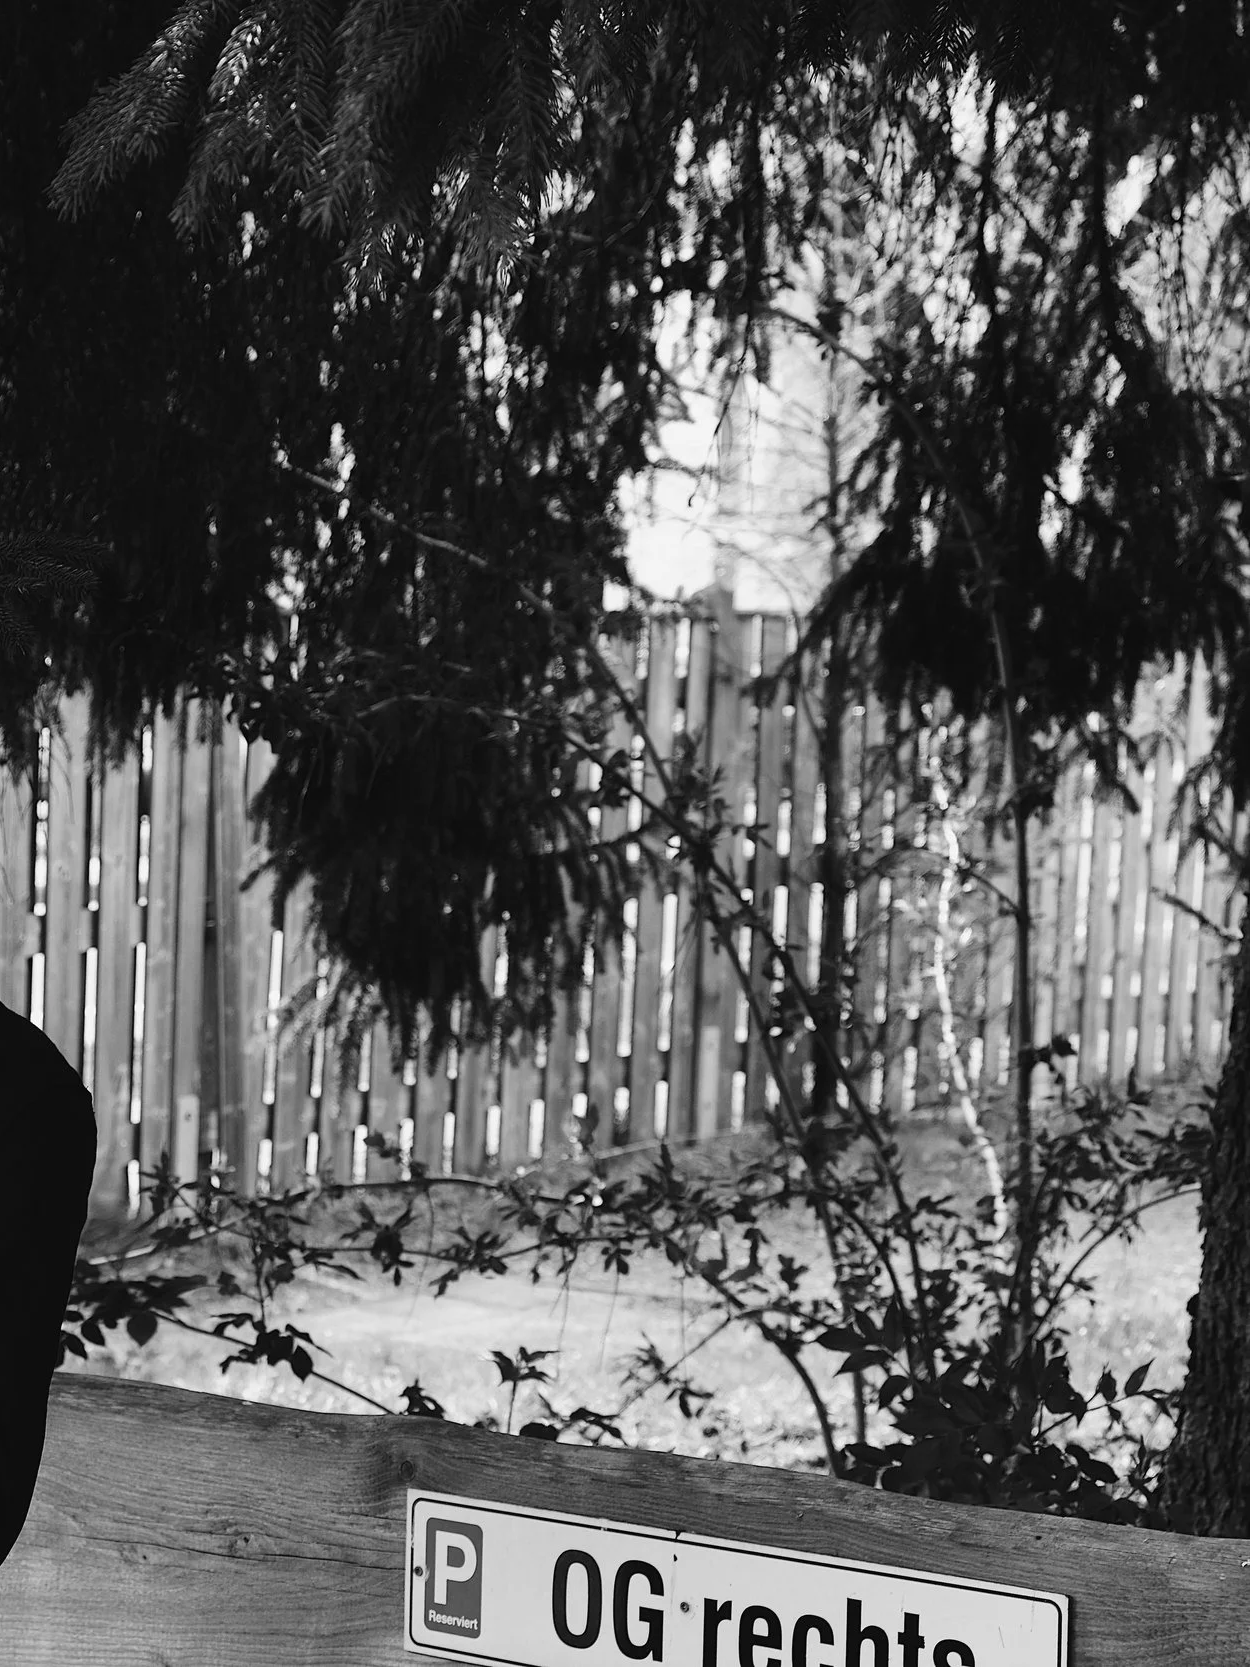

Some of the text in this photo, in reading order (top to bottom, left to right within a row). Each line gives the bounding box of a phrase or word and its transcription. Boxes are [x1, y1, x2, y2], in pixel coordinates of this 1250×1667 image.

[433, 1530, 477, 1605] P
[428, 1609, 478, 1630] Reserviert
[552, 1549, 664, 1662] OG
